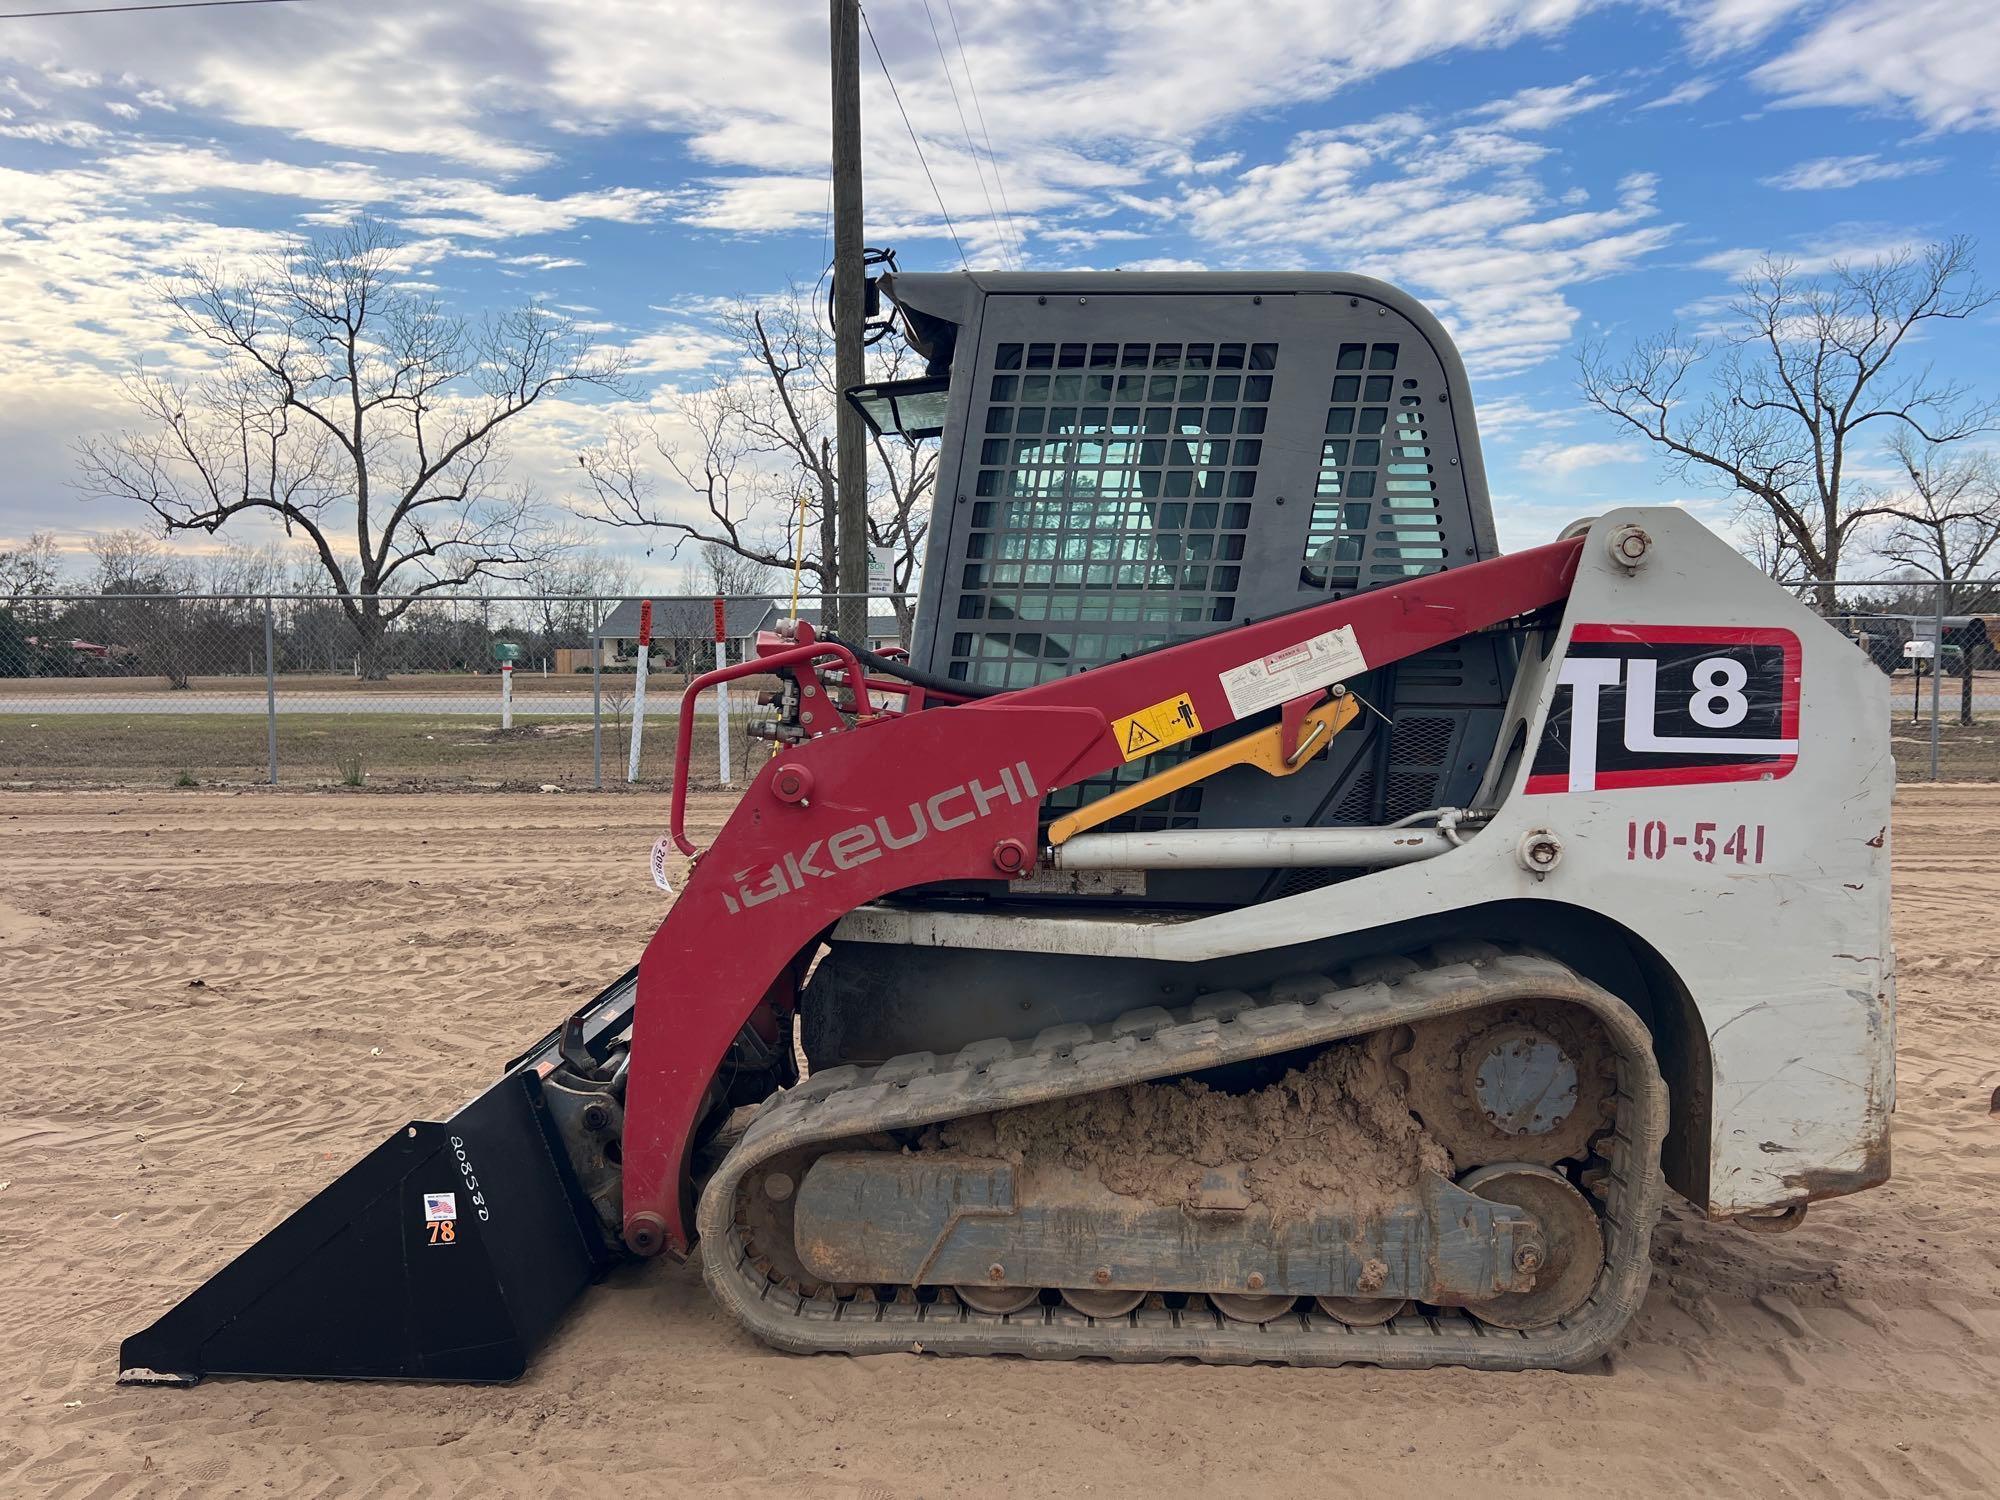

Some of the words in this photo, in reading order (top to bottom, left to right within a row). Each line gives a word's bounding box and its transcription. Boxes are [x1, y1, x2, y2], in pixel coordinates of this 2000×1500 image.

[1557, 657, 1799, 793] TL8
[1626, 820, 1765, 865] 10-541
[450, 1136, 489, 1221] 208580
[426, 1220, 456, 1243] 78
